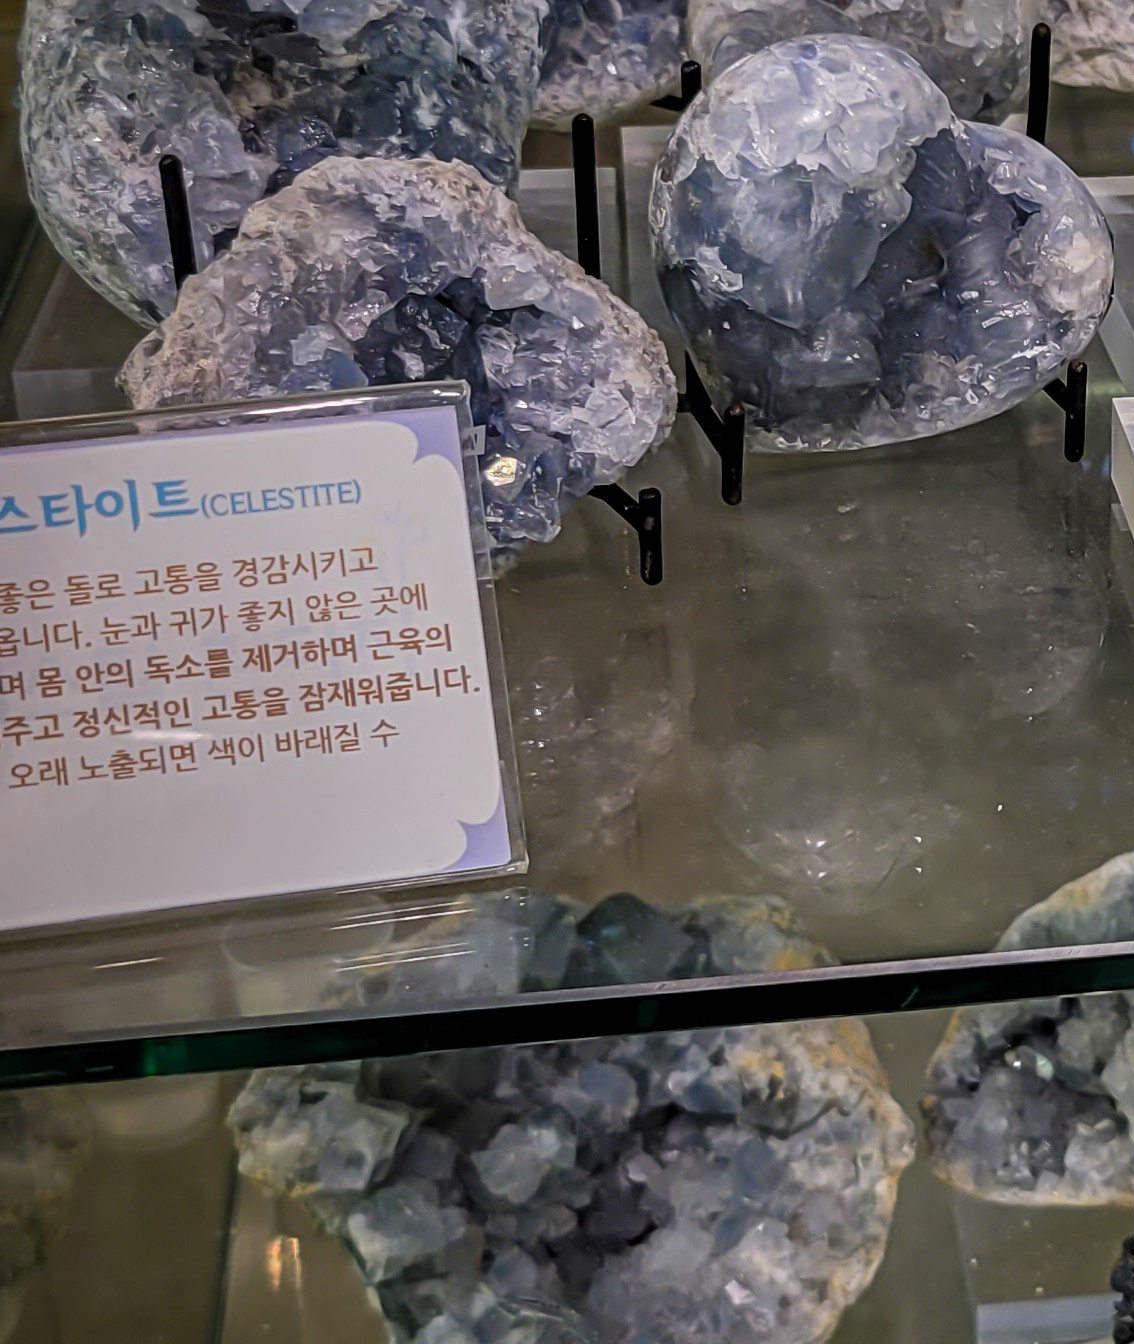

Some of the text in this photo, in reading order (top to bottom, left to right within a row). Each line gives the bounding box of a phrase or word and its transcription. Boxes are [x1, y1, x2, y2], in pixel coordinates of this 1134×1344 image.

[0, 546, 379, 615] 좋은 돌로 고통을 경감시키고
[100, 611, 162, 646] 눈과
[168, 604, 230, 638] 귀가
[237, 597, 295, 632] 좋지
[305, 590, 363, 623] 않은
[369, 583, 429, 617] 곳에
[36, 666, 67, 699] 몸
[75, 658, 135, 694] 안의
[143, 648, 234, 685] 독소를
[241, 633, 359, 673] 제거하며
[366, 623, 453, 661] 근육의
[73, 697, 193, 738] 정신적인
[201, 686, 291, 721] 고통을
[298, 664, 481, 713] 잠재워줍니다.
[8, 718, 401, 789] 오래 노출되면 색이 바래질 수
